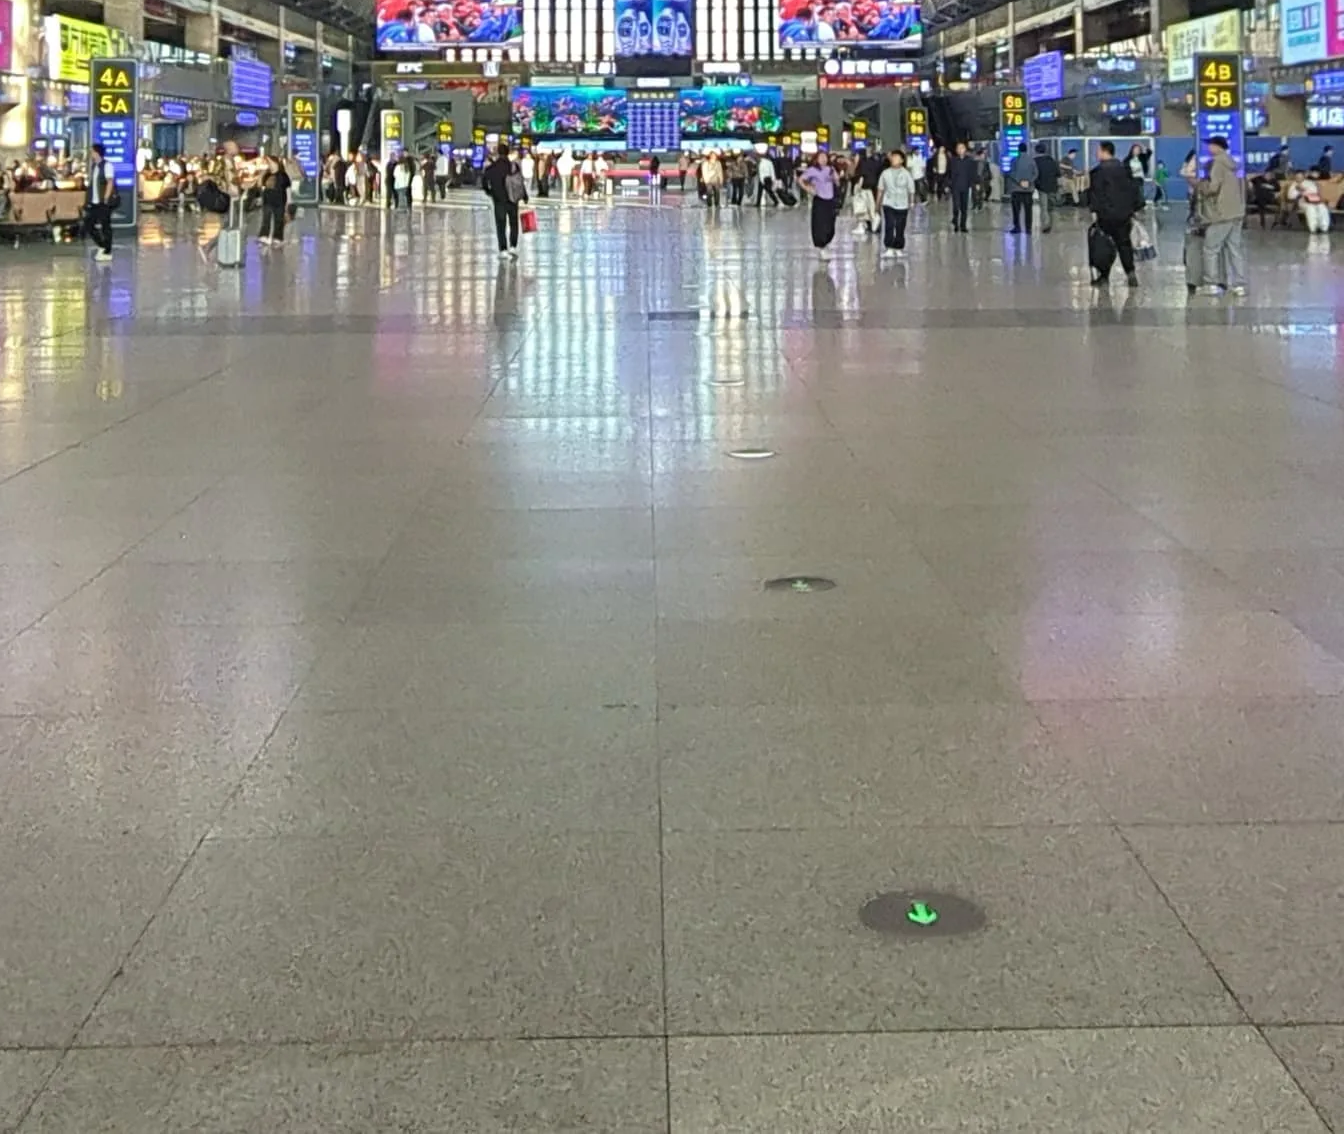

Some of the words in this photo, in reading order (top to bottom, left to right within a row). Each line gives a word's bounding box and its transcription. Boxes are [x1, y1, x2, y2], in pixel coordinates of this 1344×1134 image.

[100, 68, 129, 87] 4A
[1204, 61, 1232, 80] 4B
[100, 95, 128, 114] 5A
[1004, 95, 1023, 108] 6B
[1205, 88, 1233, 107] 5B
[295, 117, 313, 130] 7A
[1005, 113, 1023, 125] 7B
